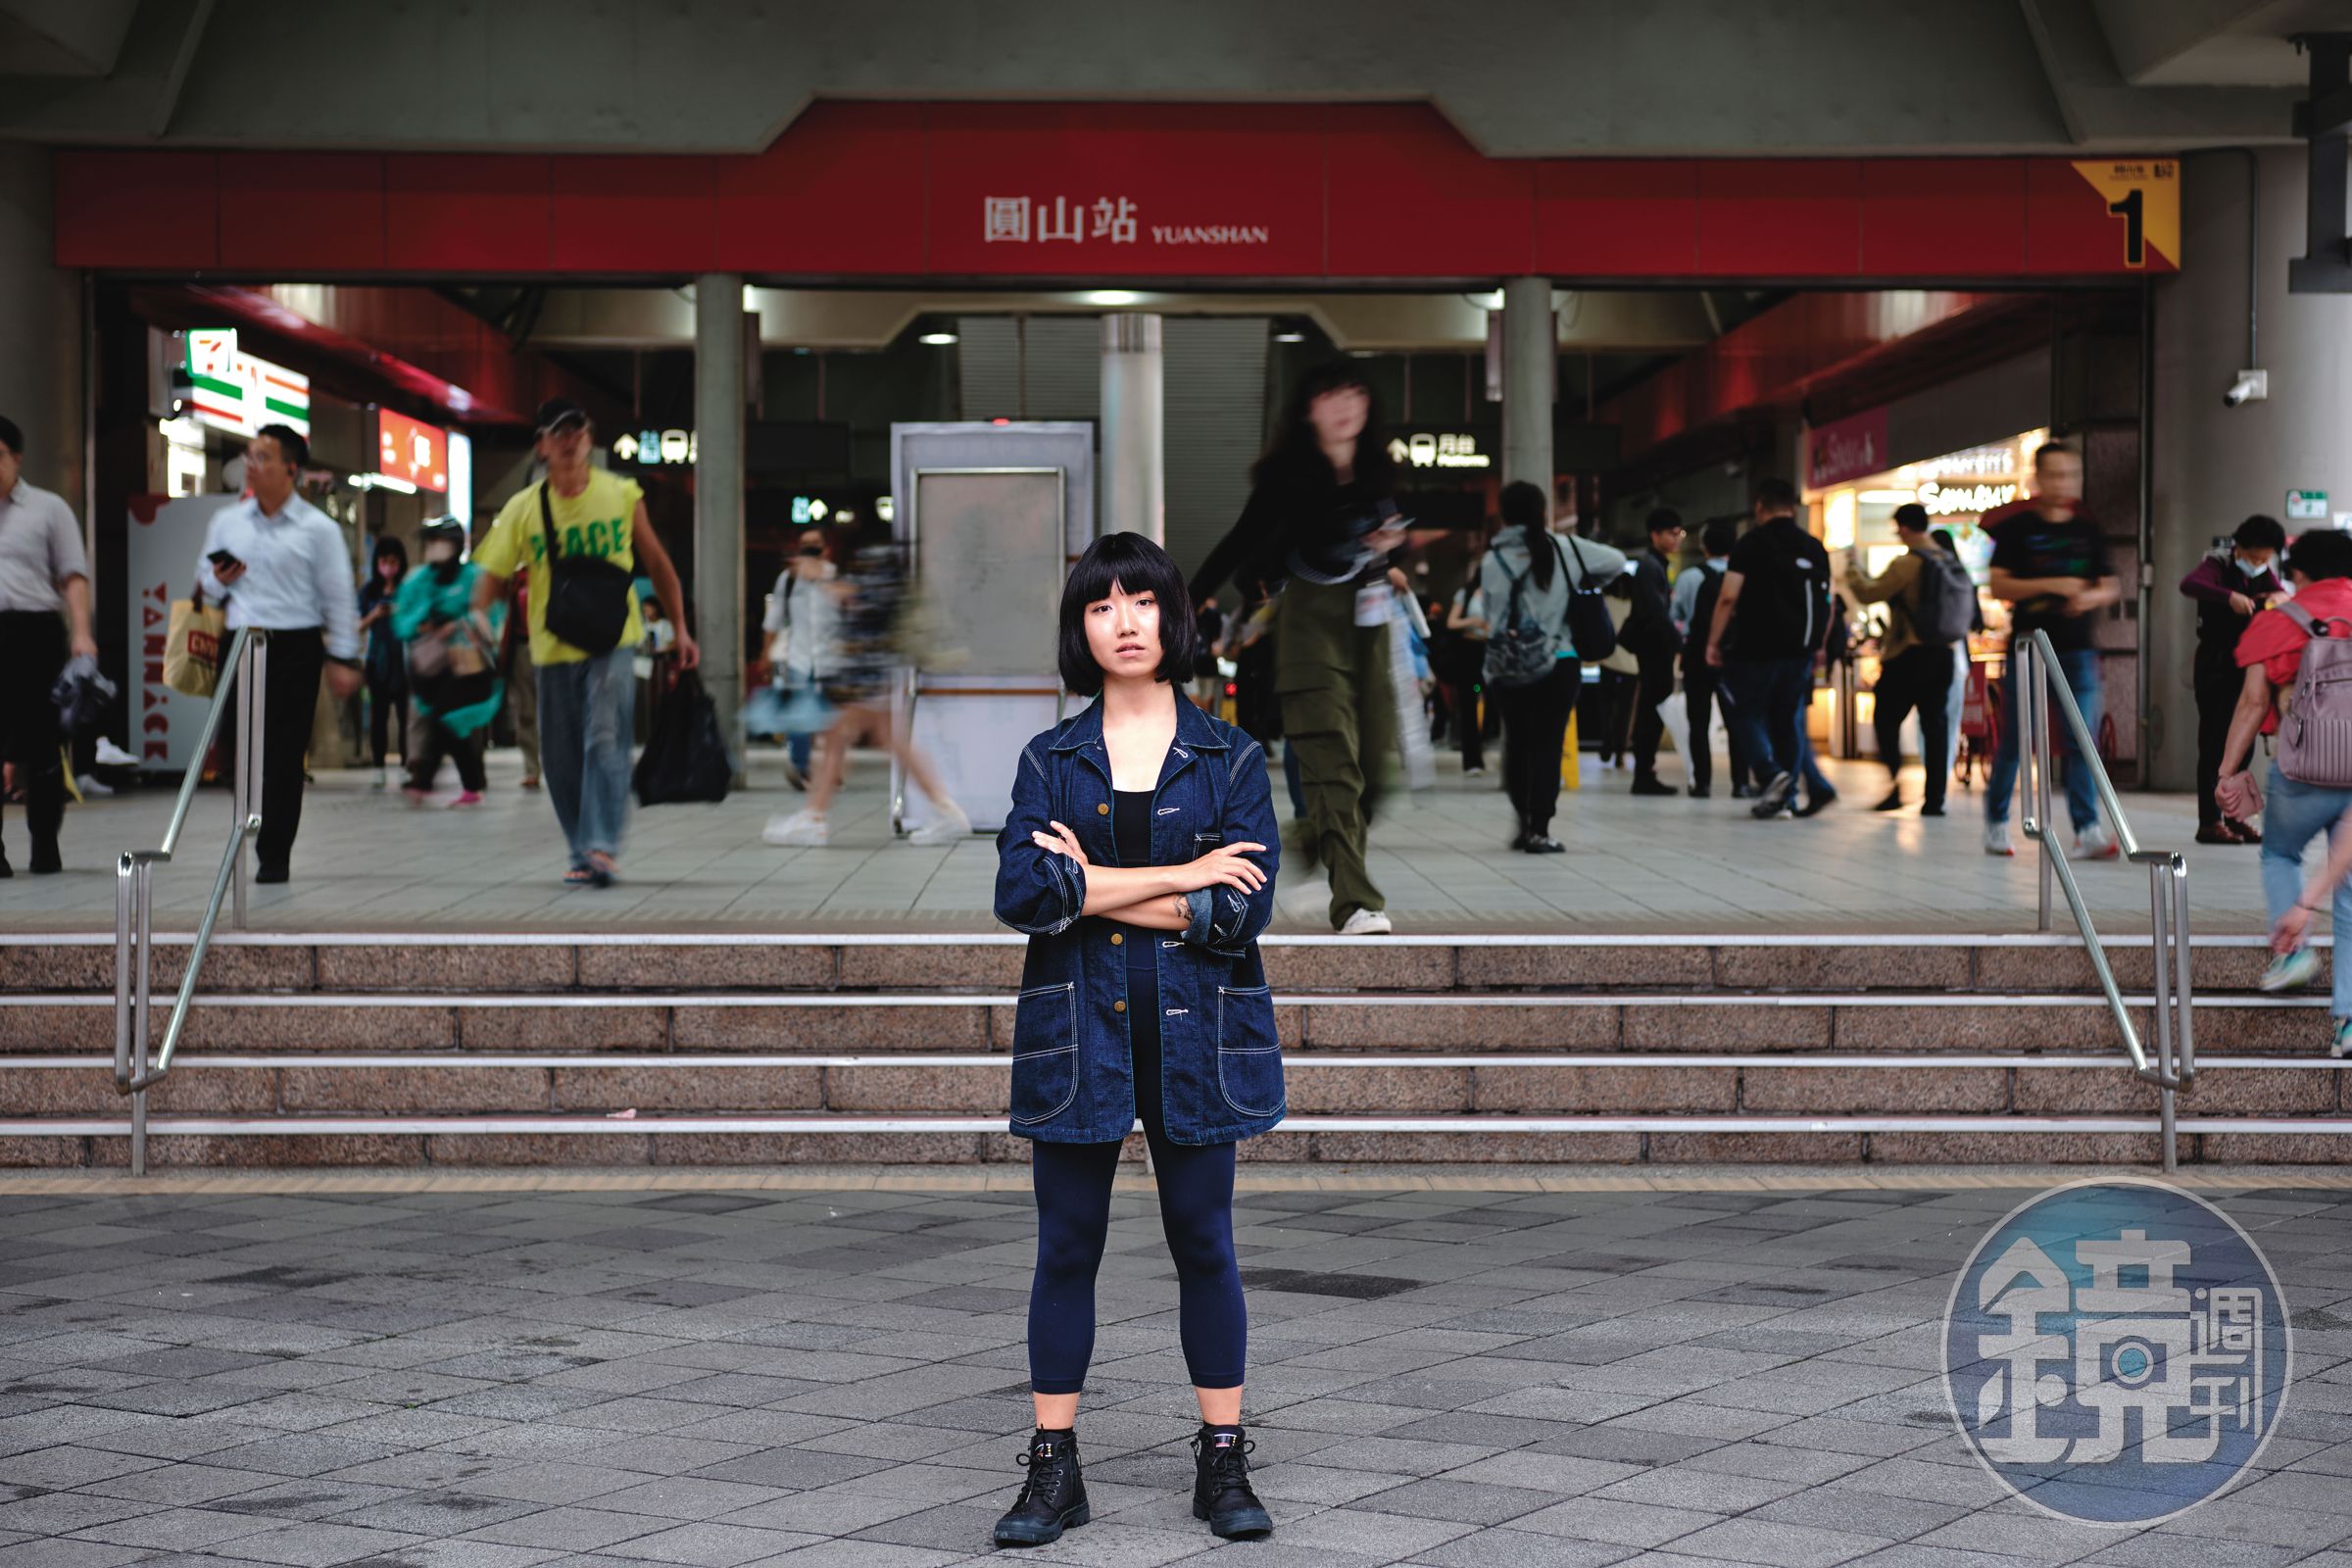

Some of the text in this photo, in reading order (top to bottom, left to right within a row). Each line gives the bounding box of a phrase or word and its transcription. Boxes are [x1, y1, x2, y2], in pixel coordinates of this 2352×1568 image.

[985, 196, 1268, 244] 圓山站 YUANSHAN
[2110, 188, 2143, 264] 1
